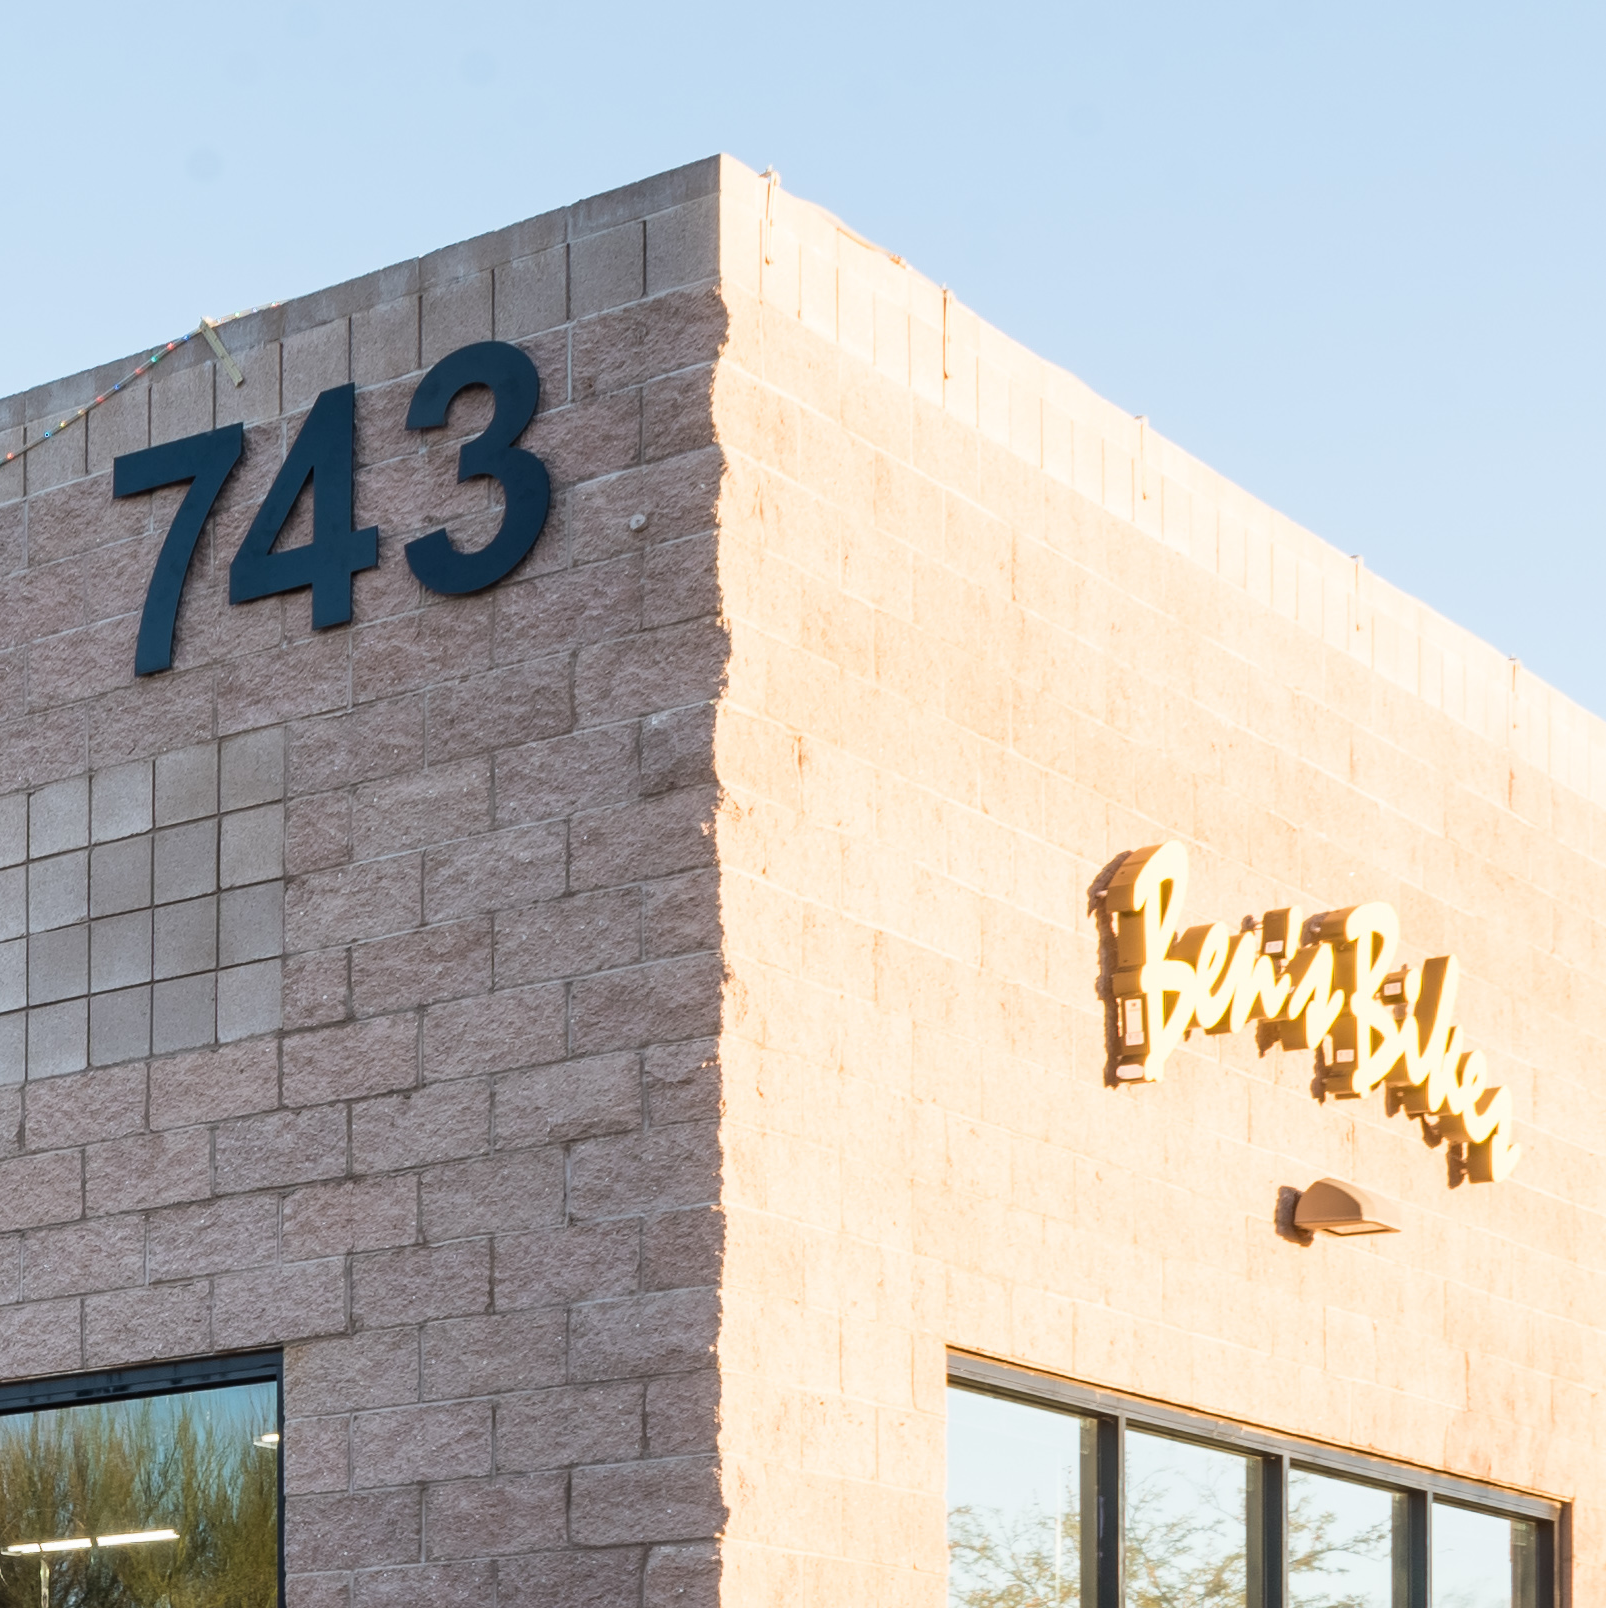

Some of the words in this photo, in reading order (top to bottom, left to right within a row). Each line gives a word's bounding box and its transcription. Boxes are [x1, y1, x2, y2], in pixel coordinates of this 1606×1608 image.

[112, 340, 552, 678] 743
[1127, 839, 1346, 1082] Ben's
[1346, 901, 1522, 1184] Bikes
